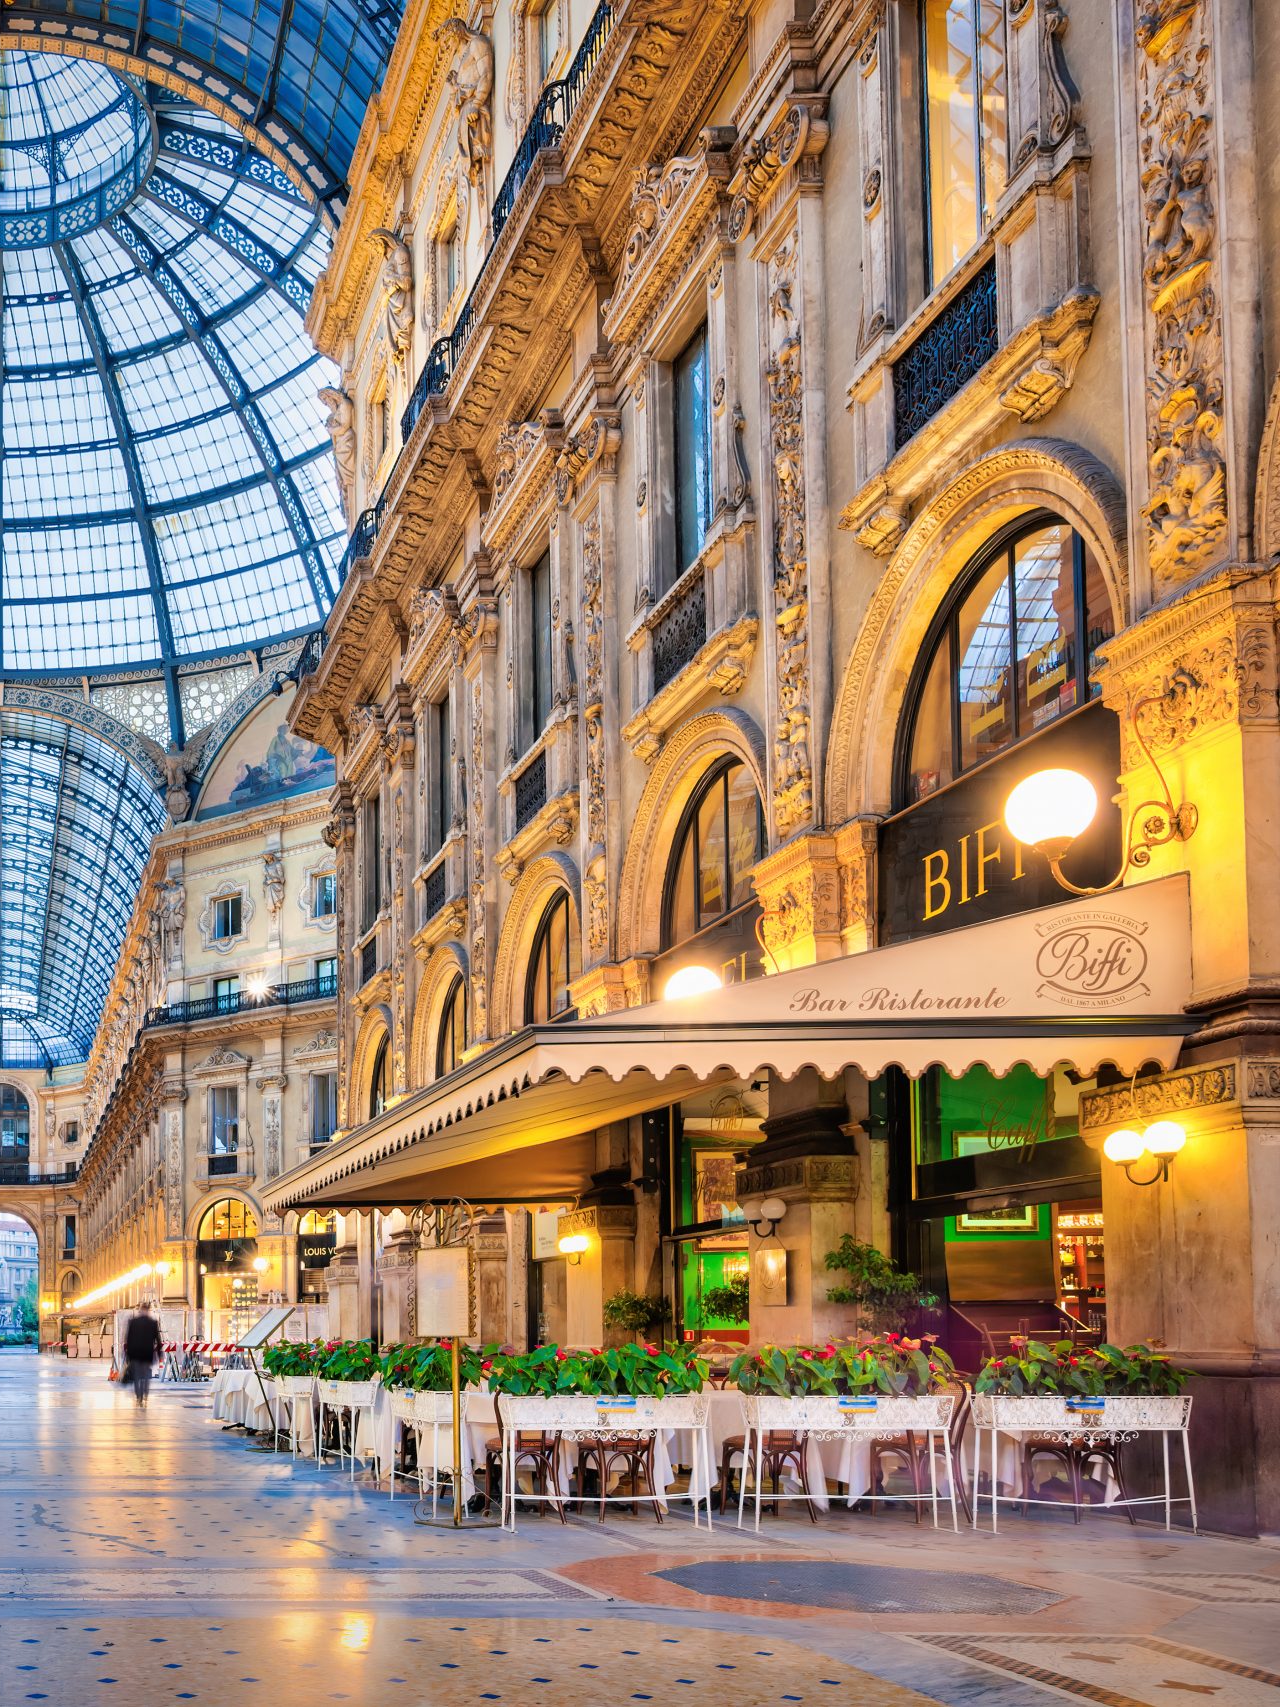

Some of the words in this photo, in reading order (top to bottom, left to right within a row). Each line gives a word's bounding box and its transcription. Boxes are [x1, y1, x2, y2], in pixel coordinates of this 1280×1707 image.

[1046, 913, 1091, 932] RISTORANTE
[1093, 912, 1101, 920] IN
[1102, 913, 1140, 931] GALLERIA
[1050, 932, 1132, 991] Biffi
[789, 988, 854, 1012] Bar
[858, 987, 1011, 1012] Ristorante
[1060, 995, 1074, 1005] DAL
[1076, 999, 1090, 1007] 1867
[1097, 995, 1126, 1007] MILANO
[304, 1247, 327, 1256] LOUIS
